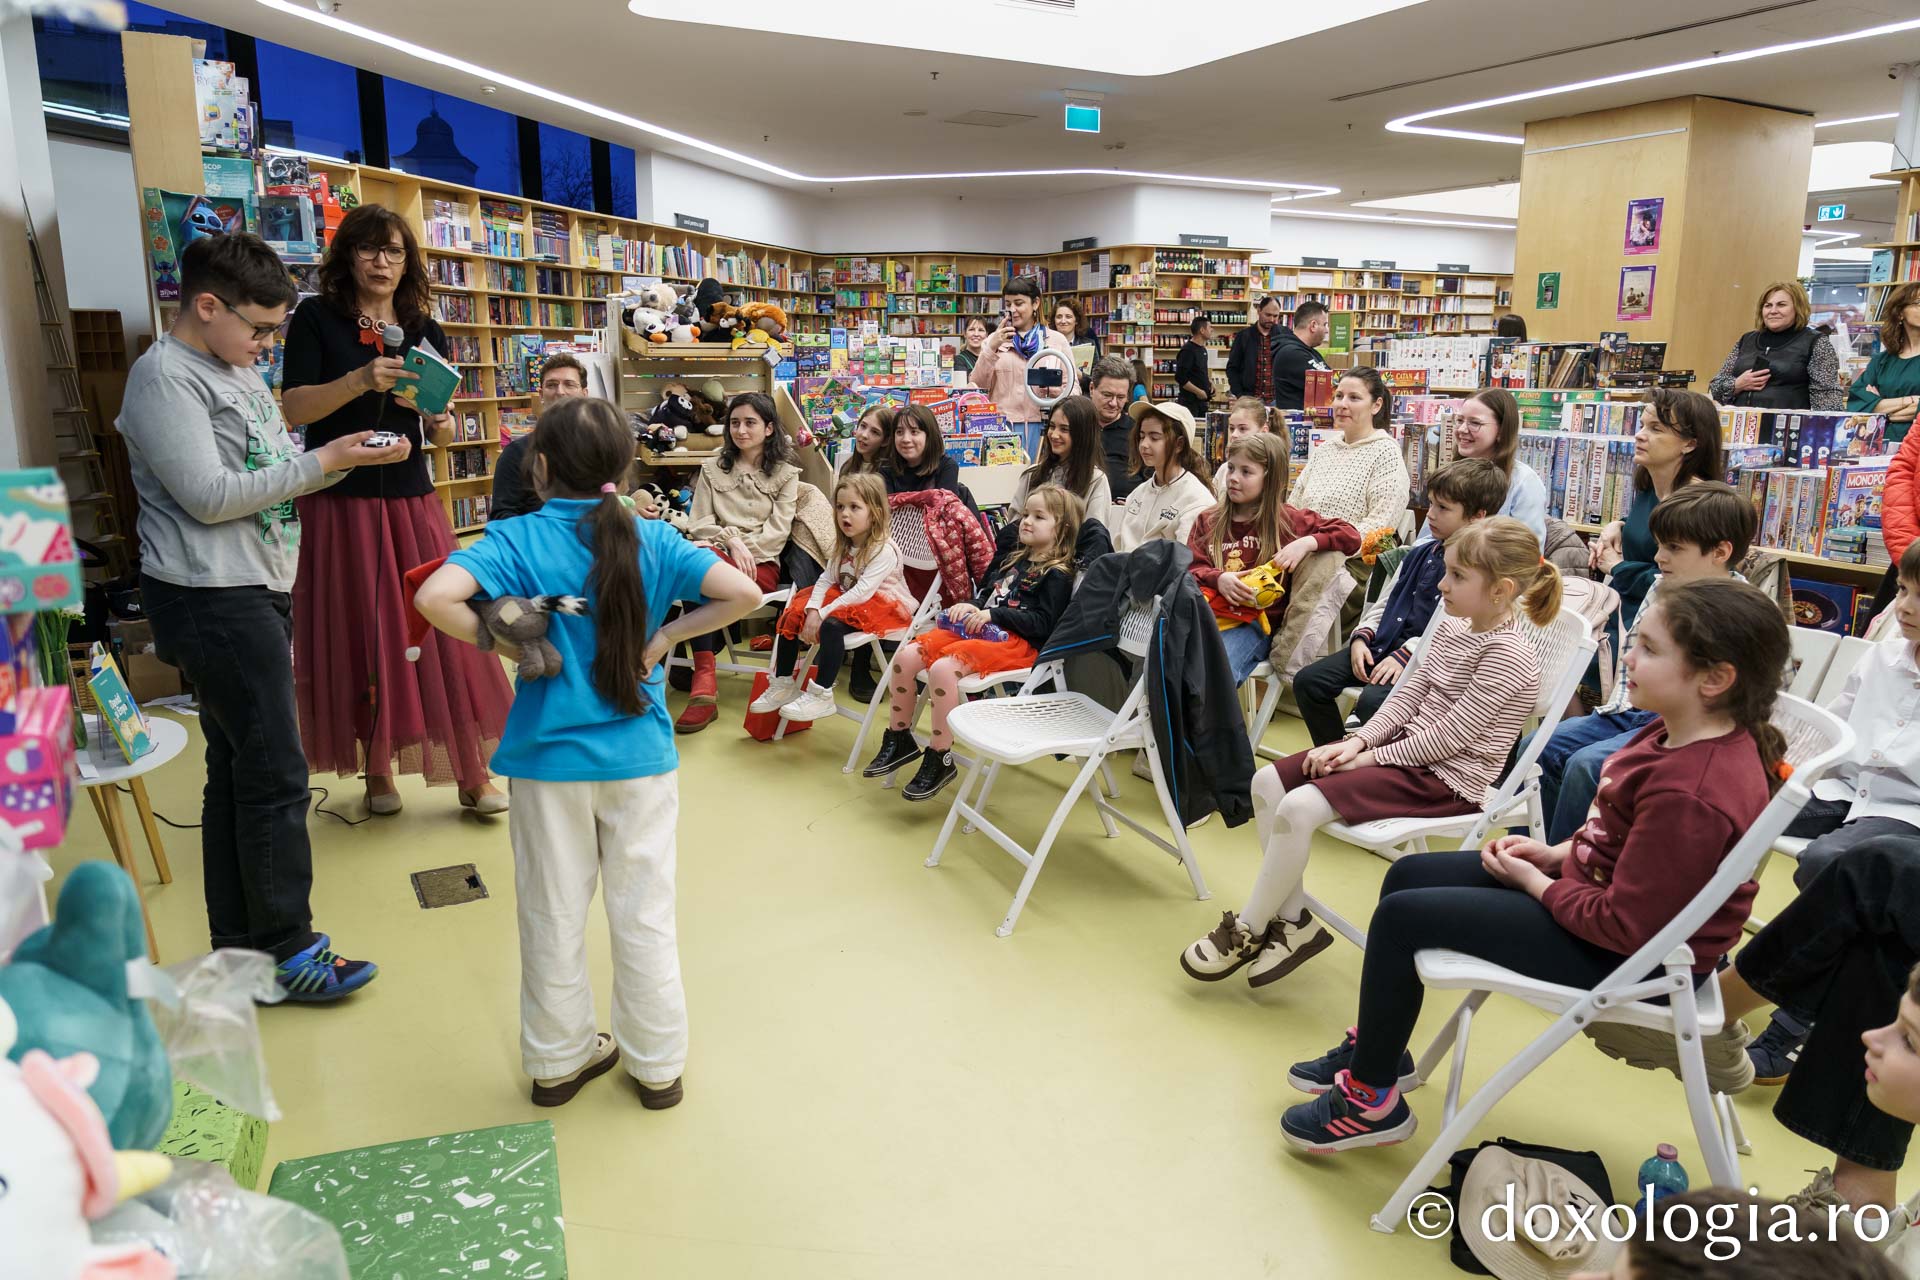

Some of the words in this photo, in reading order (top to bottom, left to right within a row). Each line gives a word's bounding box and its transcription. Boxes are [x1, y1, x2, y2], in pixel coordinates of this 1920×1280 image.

[1396, 371, 1413, 380] CATAN
[1734, 413, 1743, 444] MONOPOL
[1748, 415, 1758, 444] OPOLY
[1570, 459, 1579, 478] RIDE
[1594, 446, 1606, 476] TICKET
[1830, 470, 1841, 504] MONOPOLY
[1848, 474, 1885, 487] MONOPO
[1566, 489, 1577, 518] TICKET
[1591, 486, 1602, 506] RIDE
